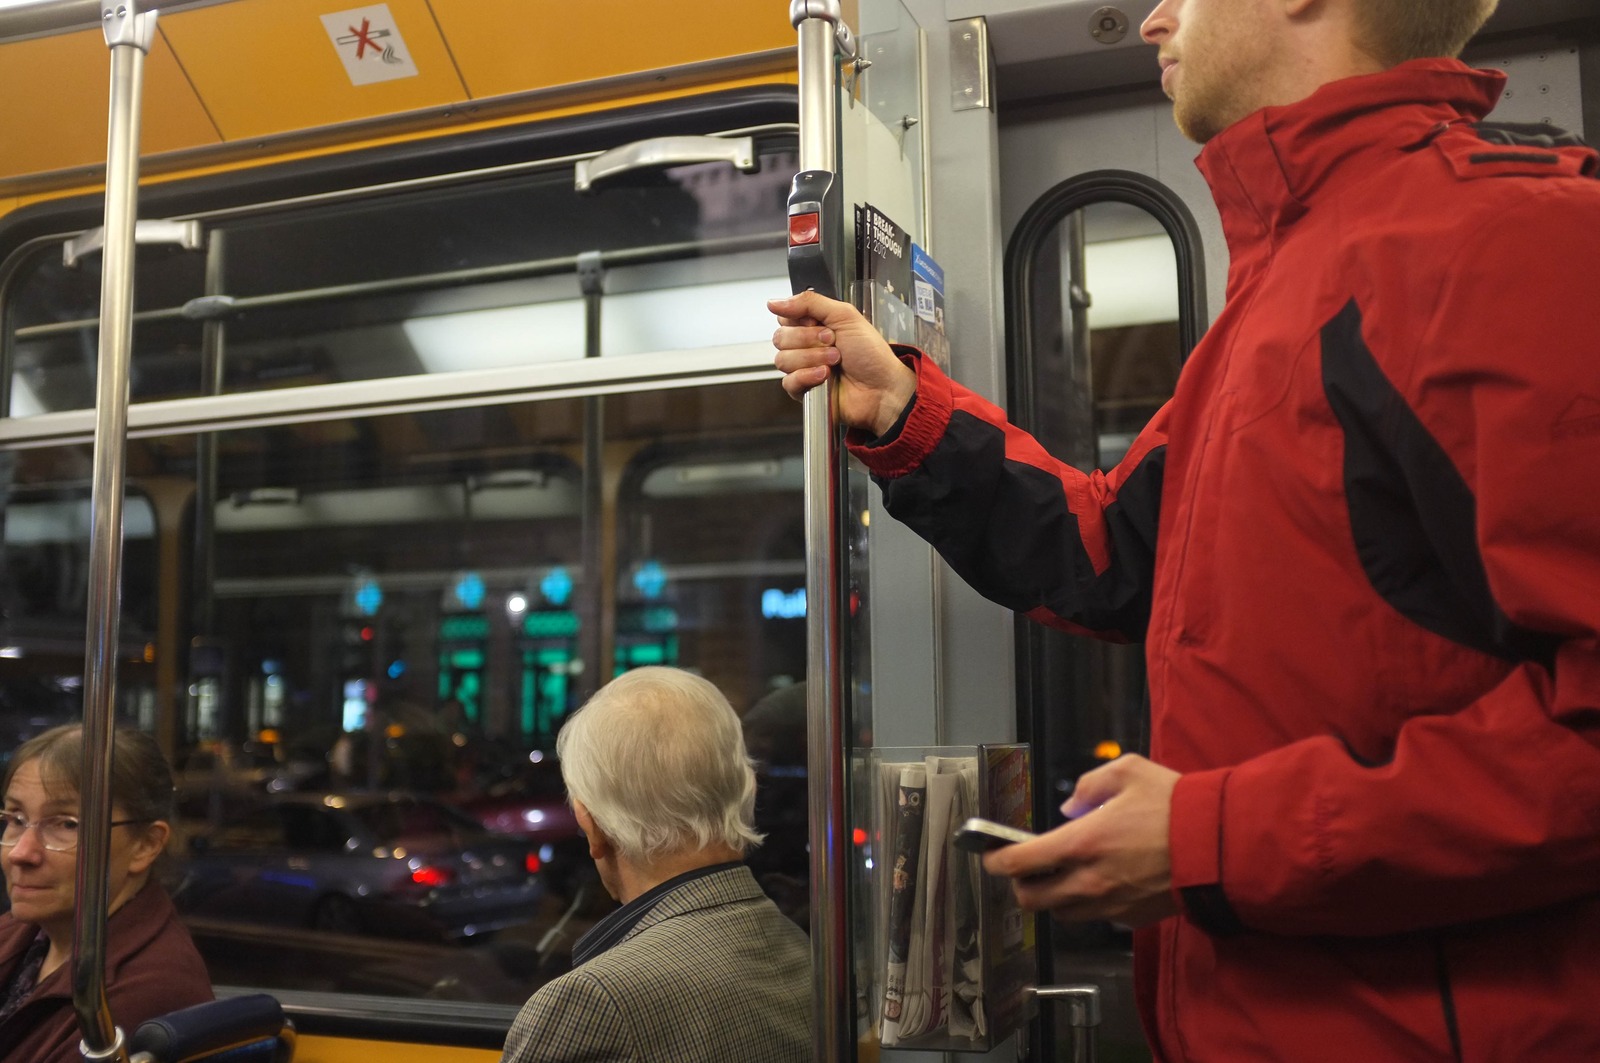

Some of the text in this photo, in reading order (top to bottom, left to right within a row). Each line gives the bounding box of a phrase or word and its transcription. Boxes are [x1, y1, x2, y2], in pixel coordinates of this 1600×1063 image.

[873, 212, 895, 239] BREAK-
[873, 225, 902, 259] THROUGH
[873, 239, 886, 259] 2012
